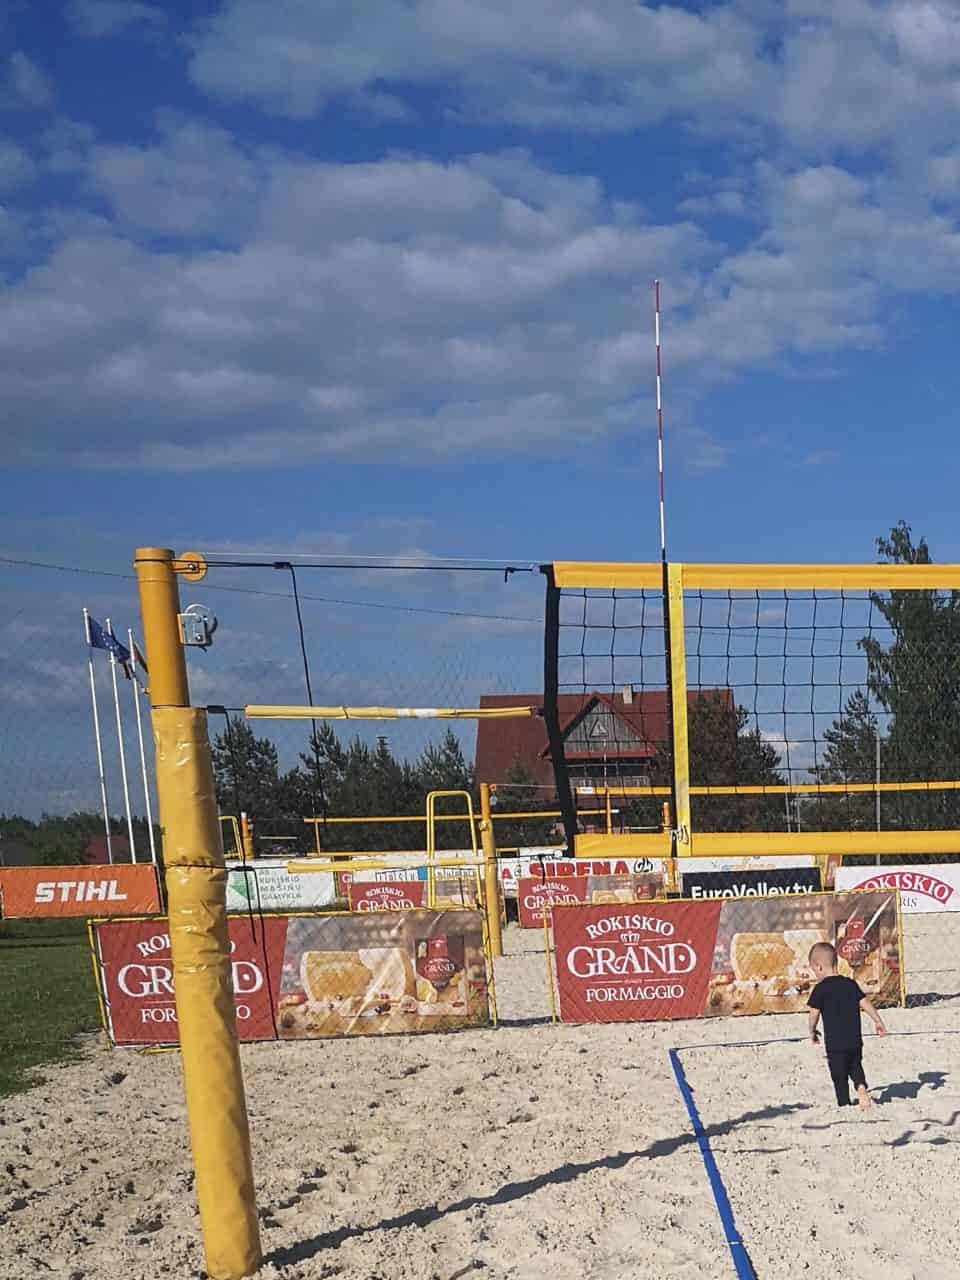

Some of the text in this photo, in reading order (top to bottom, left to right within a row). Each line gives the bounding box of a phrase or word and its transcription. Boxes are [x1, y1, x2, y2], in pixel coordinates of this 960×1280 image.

[35, 880, 128, 903] STIHL
[691, 882, 813, 898] EuroVolleytv
[585, 914, 675, 939] ROKIŠKIO
[567, 943, 697, 978] GRAND
[118, 961, 263, 997] GRD
[585, 984, 685, 1002] FORMAGGIO
